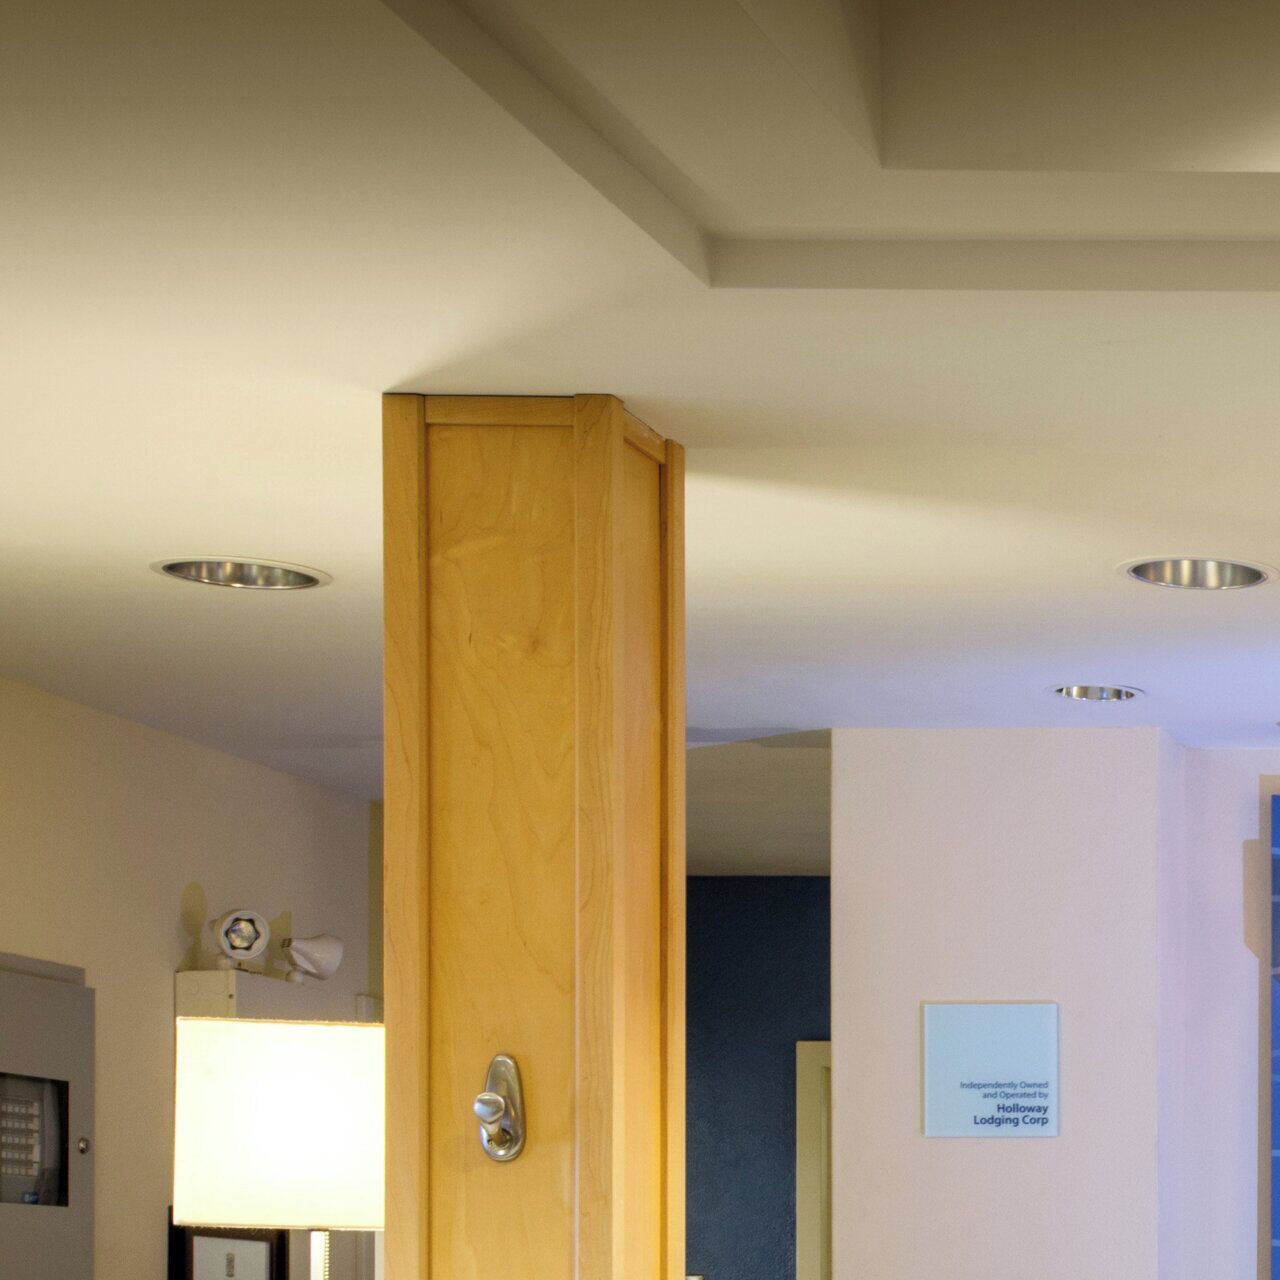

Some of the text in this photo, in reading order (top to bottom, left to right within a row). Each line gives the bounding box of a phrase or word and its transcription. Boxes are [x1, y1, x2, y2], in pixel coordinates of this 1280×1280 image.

[960, 1081, 1049, 1090] Independently Owned
[982, 1091, 1049, 1100] and Operated by
[997, 1103, 1049, 1114] Holloway
[973, 1115, 1049, 1127] Lodging Corp
